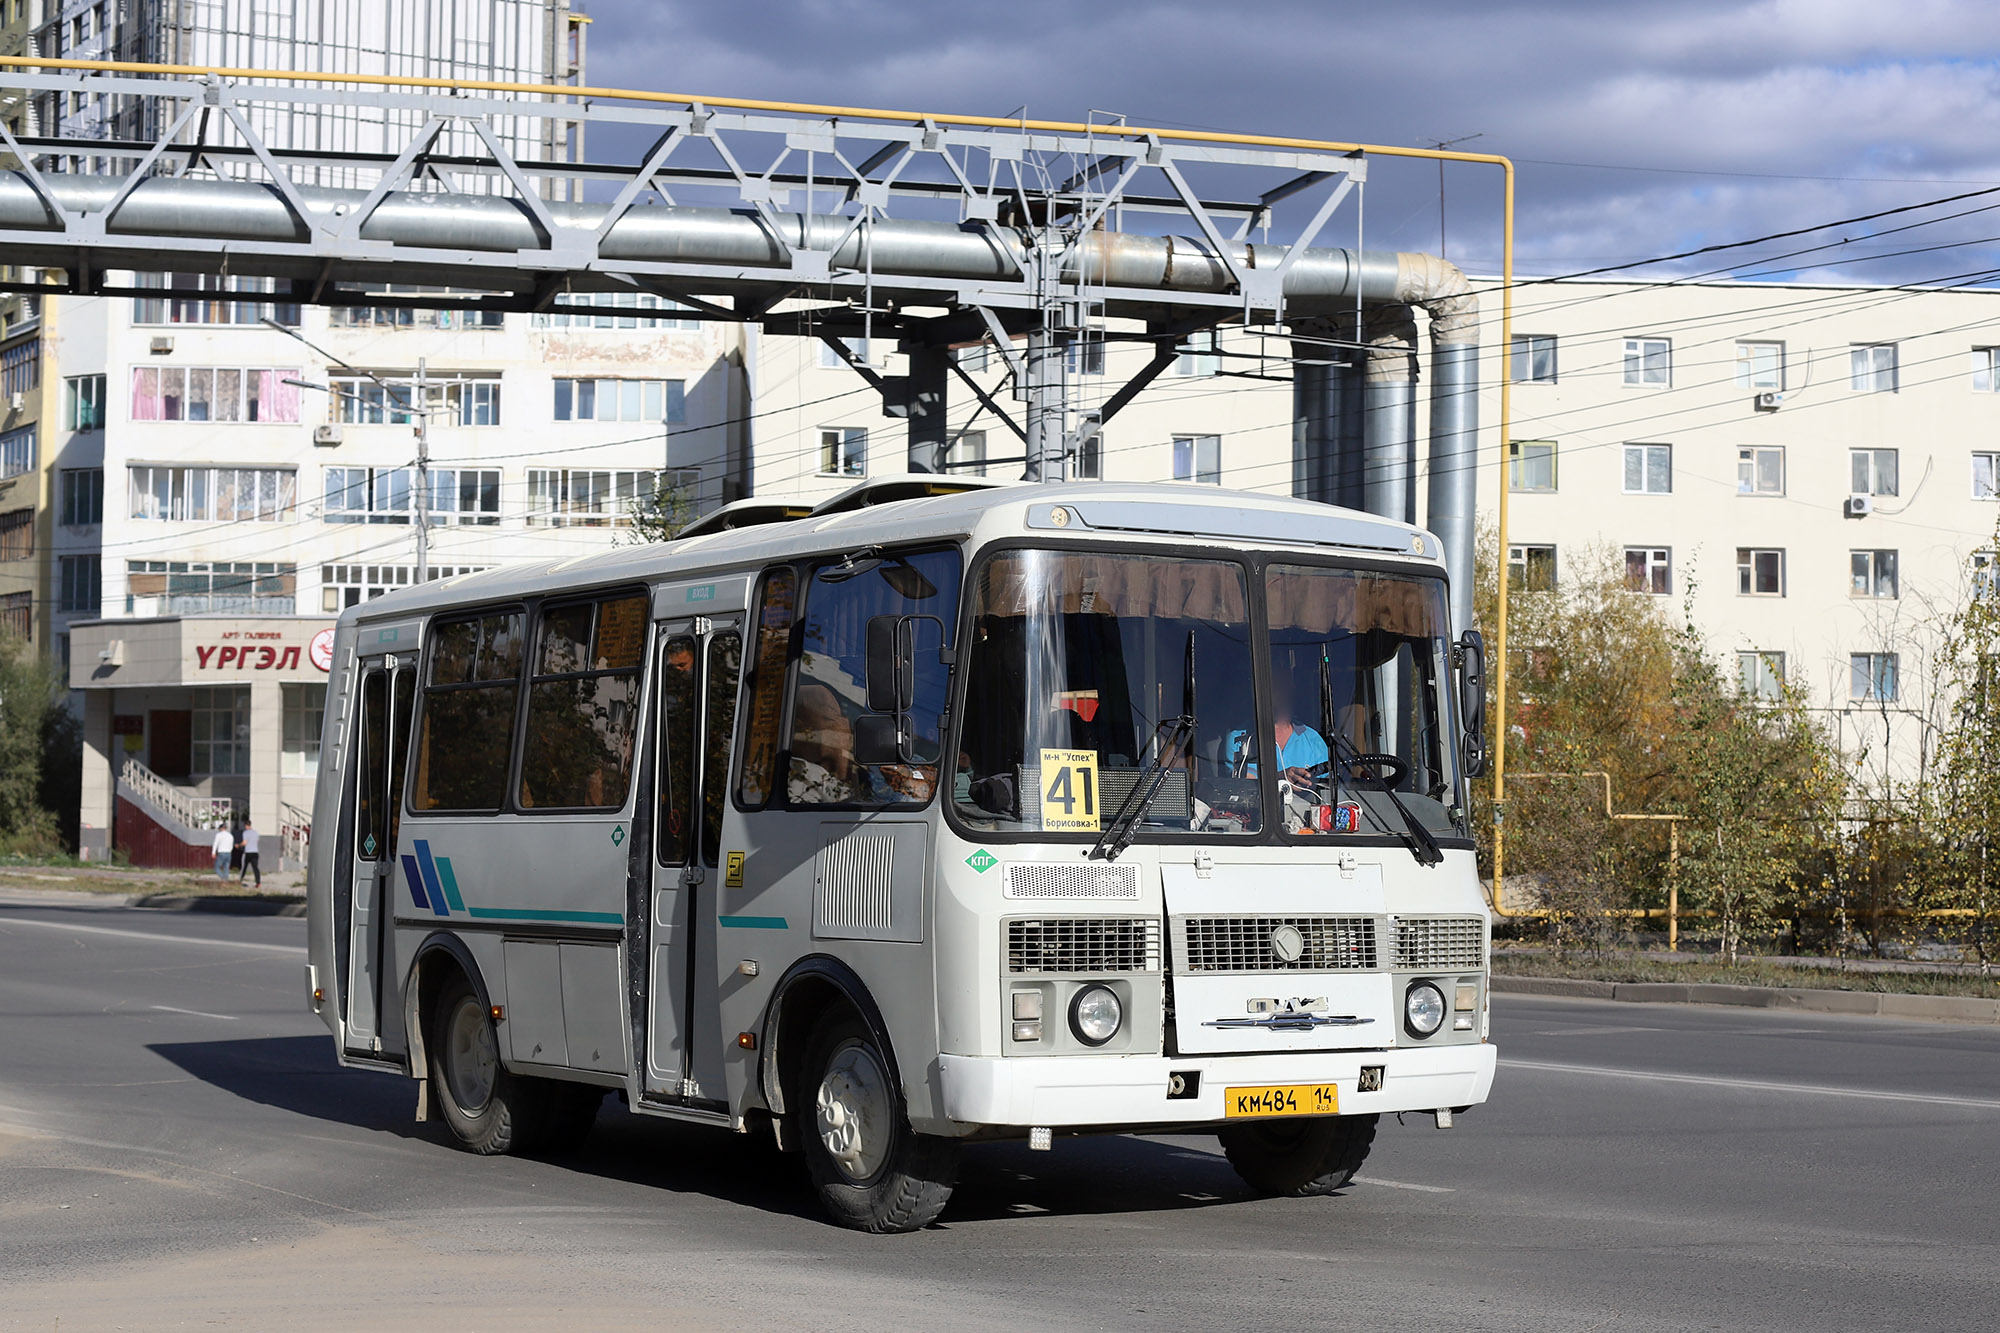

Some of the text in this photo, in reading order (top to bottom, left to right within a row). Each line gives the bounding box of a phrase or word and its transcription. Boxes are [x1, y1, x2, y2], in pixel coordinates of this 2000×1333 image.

[692, 587, 709, 599] ВХОД
[1046, 766, 1094, 815] 41
[1046, 818, 1099, 830] Борисовка-1
[971, 855, 992, 866] КПГ
[1314, 1087, 1332, 1104] 14
[1316, 1104, 1330, 1112] RUS
